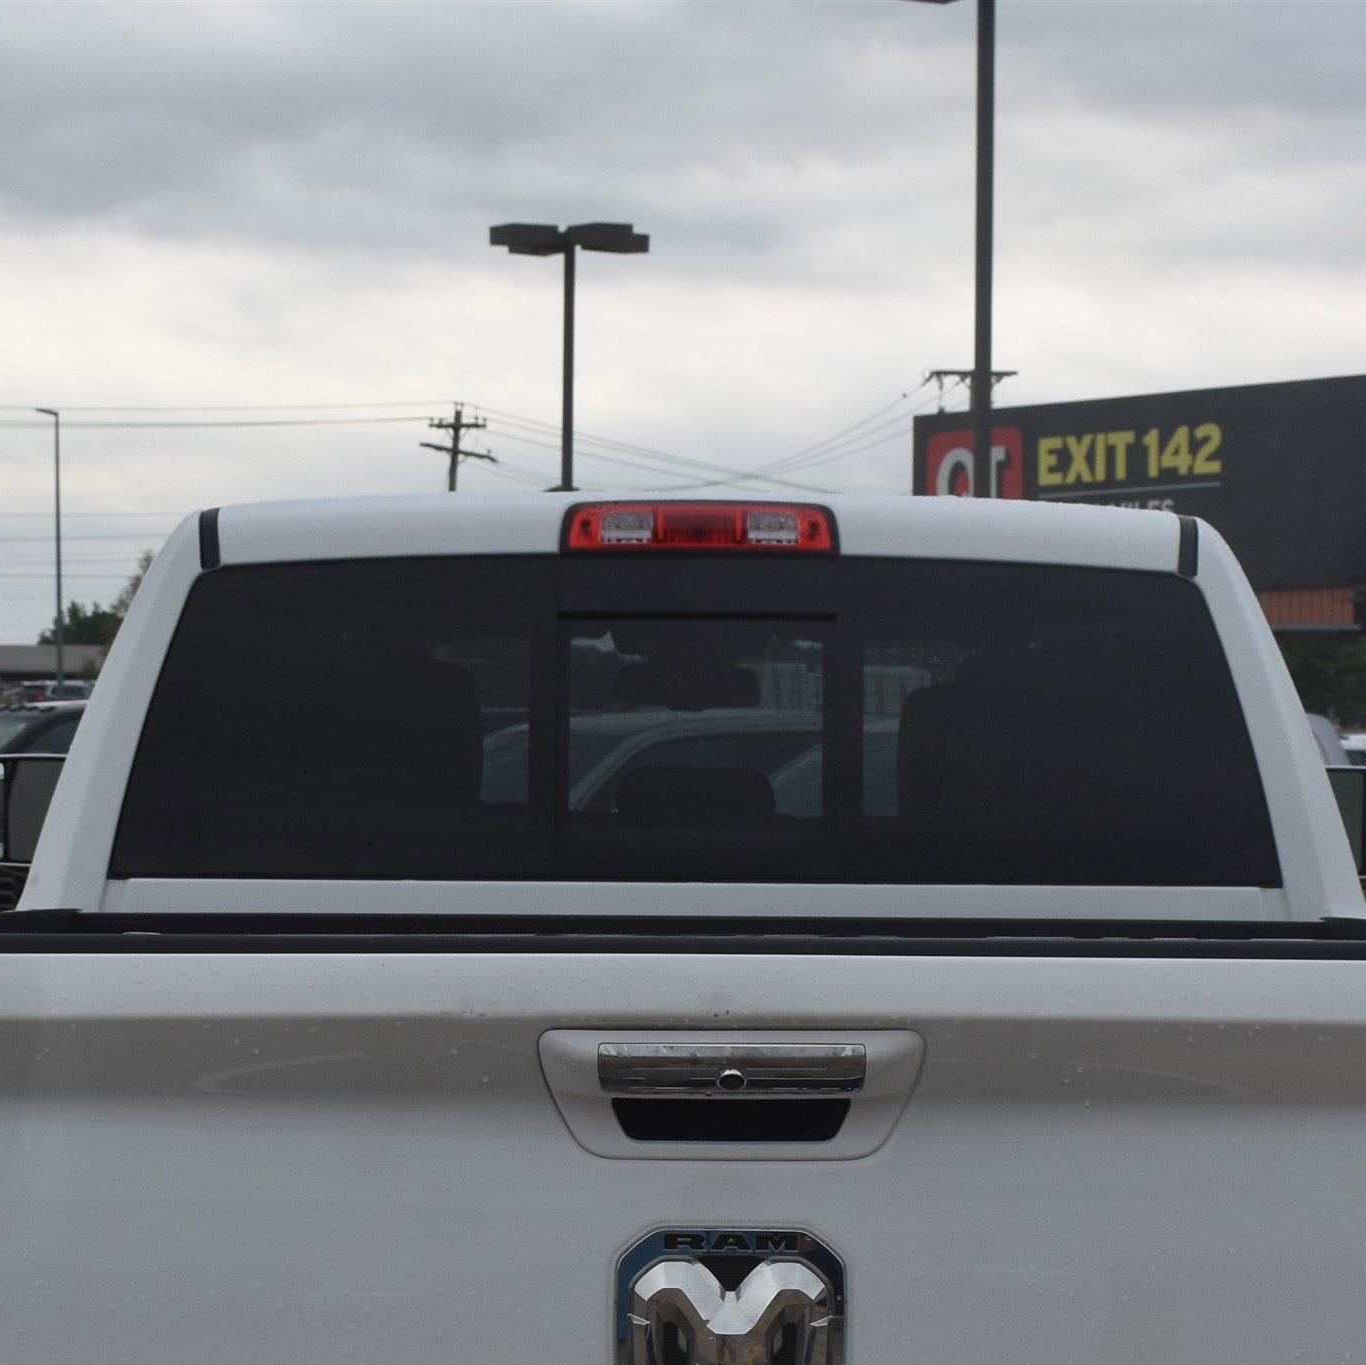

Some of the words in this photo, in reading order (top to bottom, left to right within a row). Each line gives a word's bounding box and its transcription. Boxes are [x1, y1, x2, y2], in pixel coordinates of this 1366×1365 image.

[1038, 430, 1135, 486] EXIT
[1142, 422, 1222, 478] 142
[663, 1233, 799, 1251] RAM
